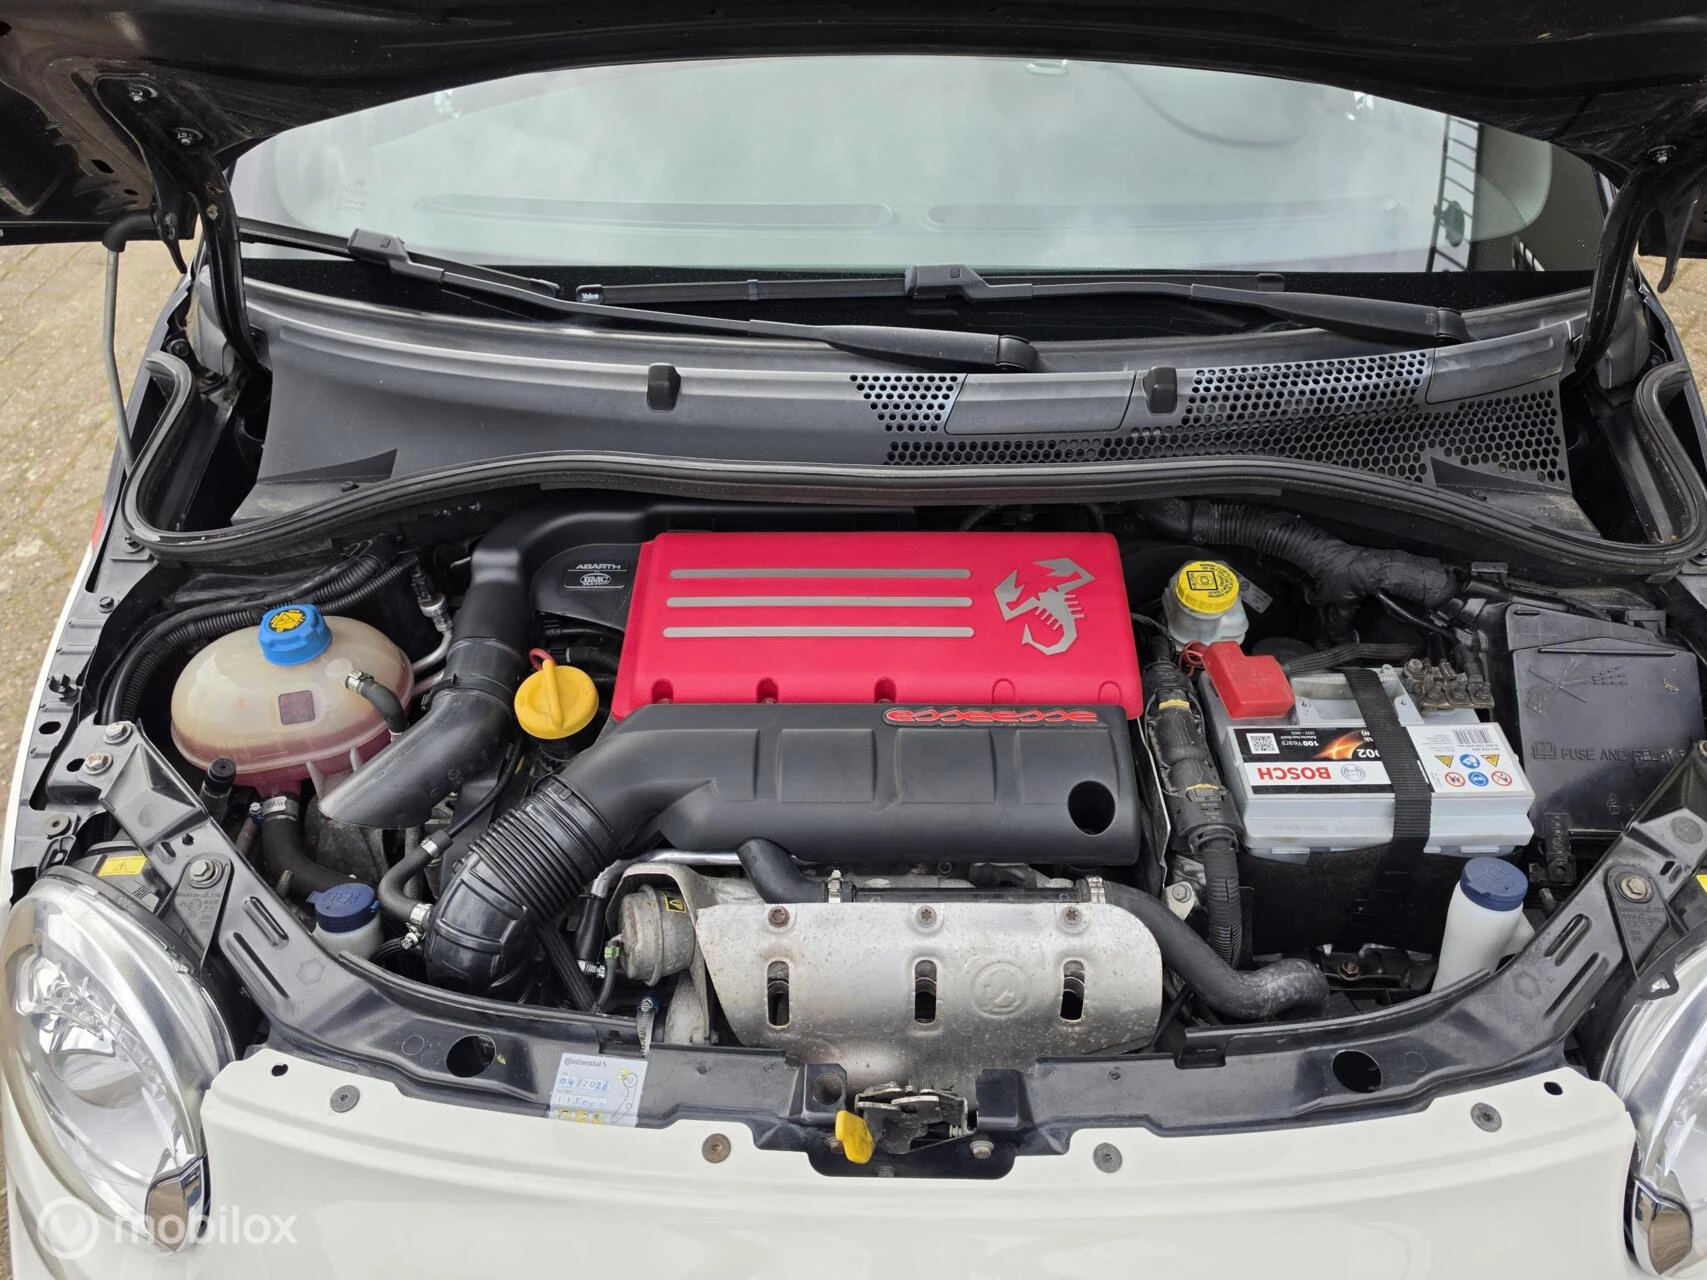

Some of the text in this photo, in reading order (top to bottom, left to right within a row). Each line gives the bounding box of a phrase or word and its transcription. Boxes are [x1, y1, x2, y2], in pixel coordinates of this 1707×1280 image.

[1560, 748, 1596, 761] FUSE
[1600, 749, 1627, 761] AND
[1257, 767, 1332, 780] BOSCH
